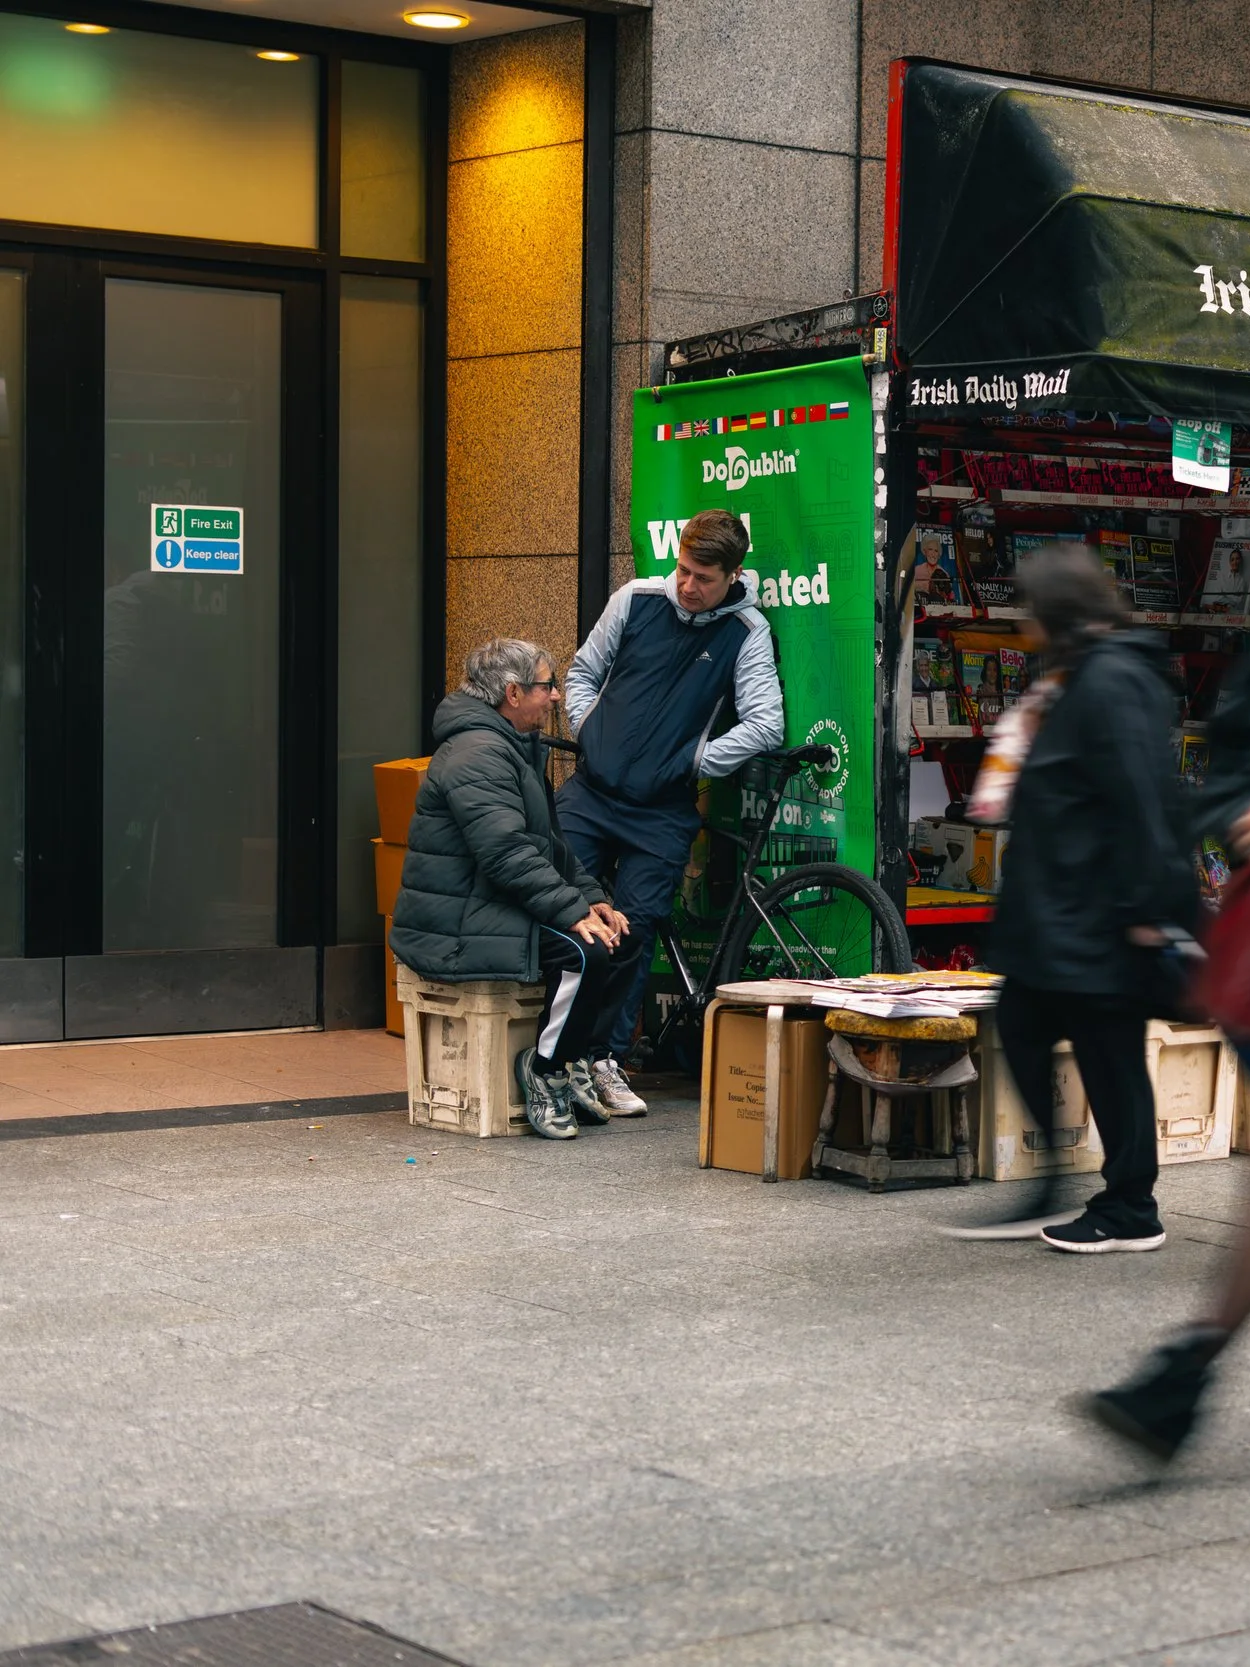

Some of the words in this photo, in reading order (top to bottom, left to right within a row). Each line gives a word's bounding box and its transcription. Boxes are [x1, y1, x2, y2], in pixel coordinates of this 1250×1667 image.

[910, 377, 960, 406] Irish
[963, 374, 1019, 411] Daily
[1022, 367, 1071, 399] Mail
[702, 446, 797, 491] DoDublin
[1112, 497, 1134, 506] Herald
[1147, 499, 1168, 508] Herald
[1229, 499, 1250, 508] Herald
[190, 518, 211, 529] Fire
[213, 519, 233, 530] Exit
[965, 527, 985, 539] HELLO!
[186, 549, 212, 562] Keep
[214, 550, 239, 561] clear
[1146, 613, 1168, 622] Herald
[1001, 650, 1025, 667] Bella
[806, 720, 825, 745] OTED
[825, 718, 842, 736] NO.1
[840, 734, 850, 755] ON
[804, 768, 819, 792] TRIP
[818, 768, 850, 799] ADVISOR
[782, 803, 803, 826] on
[821, 945, 837, 955] than
[728, 1092, 745, 1103] Issue
